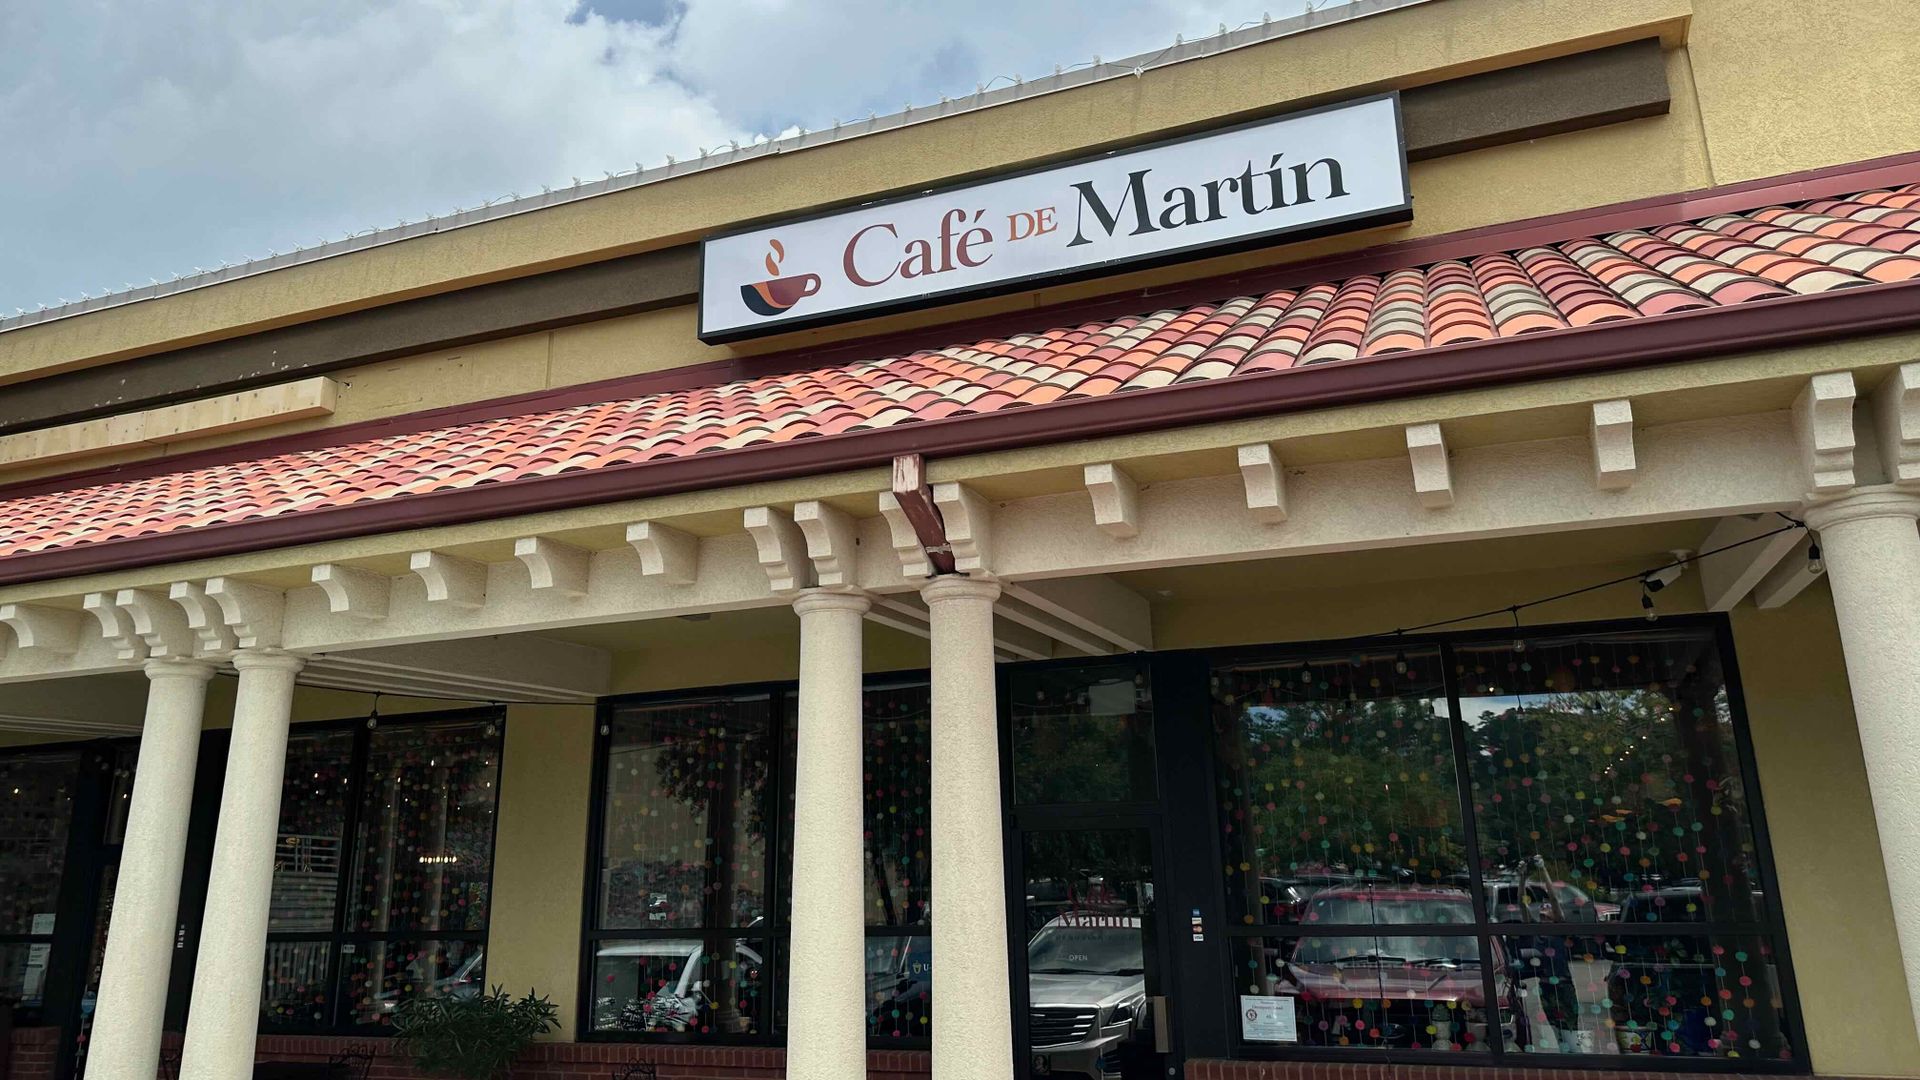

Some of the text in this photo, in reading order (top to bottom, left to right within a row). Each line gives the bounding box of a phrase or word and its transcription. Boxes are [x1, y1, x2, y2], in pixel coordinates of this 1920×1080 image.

[843, 152, 1351, 287] Café DE Martín
